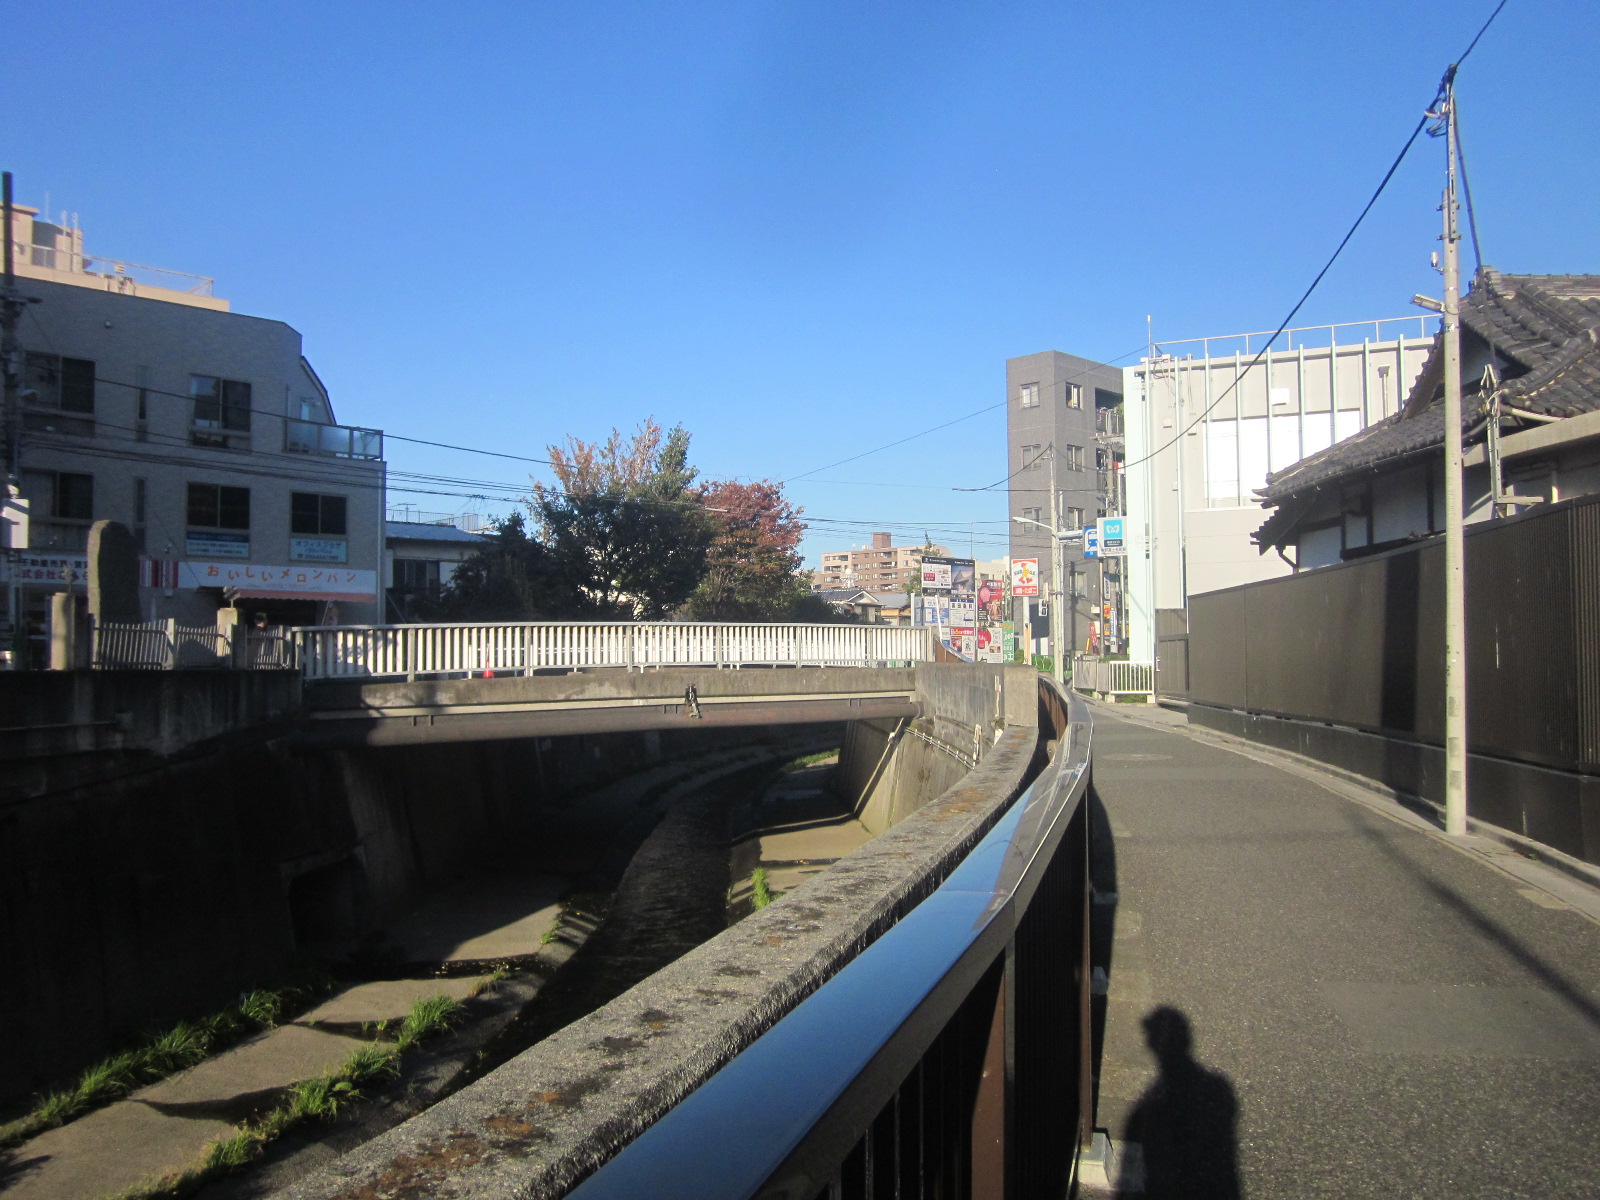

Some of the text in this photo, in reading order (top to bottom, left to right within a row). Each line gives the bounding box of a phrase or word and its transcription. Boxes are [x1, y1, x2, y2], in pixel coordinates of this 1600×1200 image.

[207, 564, 356, 583] おいしいメロンパン
